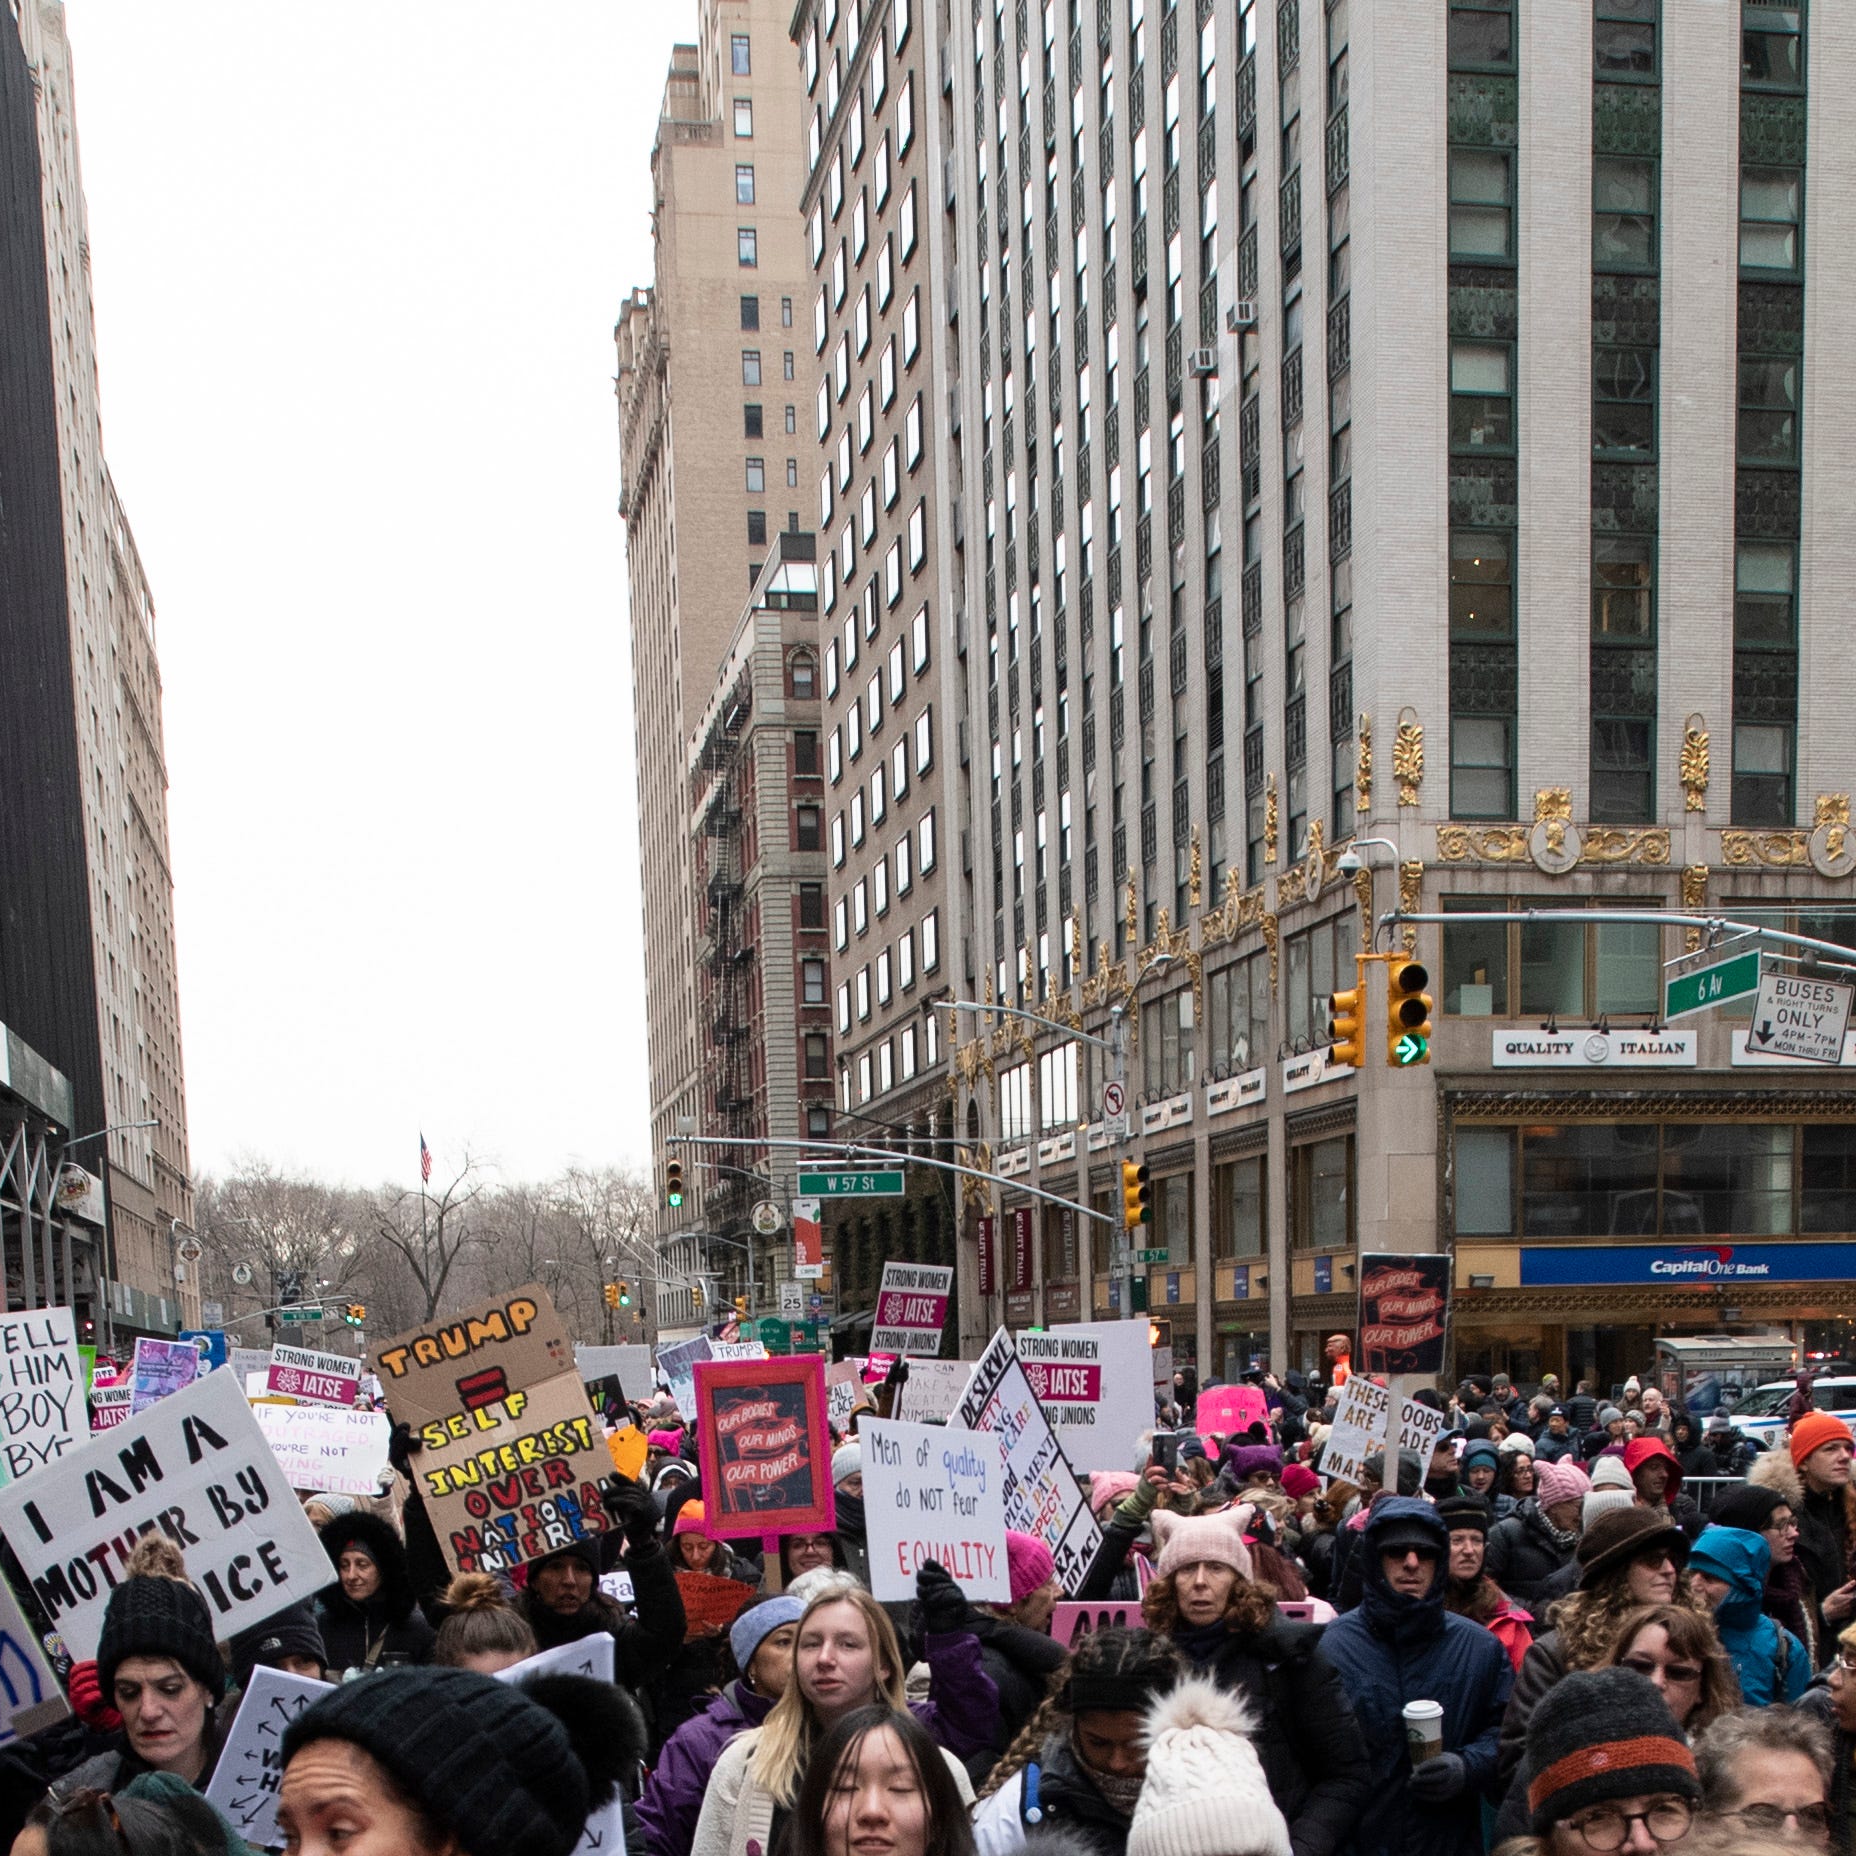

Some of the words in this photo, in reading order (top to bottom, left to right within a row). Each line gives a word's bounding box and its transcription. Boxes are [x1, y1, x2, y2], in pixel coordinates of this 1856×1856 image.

[1698, 978, 1706, 1001] 6
[1710, 975, 1723, 998] Av
[1776, 980, 1836, 1003] BUSES
[1777, 998, 1803, 1009] RIGHT
[1808, 1003, 1840, 1014] TURNS
[1776, 1009, 1824, 1029] ONLY
[1505, 1042, 1574, 1056] QUALITY
[1620, 1042, 1686, 1055] ITALIAN
[1774, 1041, 1795, 1053] MON
[826, 1178, 838, 1191] W
[842, 1177, 857, 1191] 57
[861, 1177, 875, 1191] St
[885, 1267, 917, 1287] STRONG
[919, 1271, 948, 1290] WOMEN
[1735, 1264, 1770, 1275] Bank
[1363, 1280, 1384, 1297] OUR
[783, 1298, 801, 1310] 25
[903, 1297, 937, 1324] IATSE
[1381, 1300, 1404, 1312] OUR
[378, 1298, 537, 1378] TRUMP
[874, 1330, 907, 1349] STRONG
[907, 1332, 937, 1351] UNIONS
[1364, 1327, 1394, 1344] OUR
[717, 1343, 763, 1360] TRUMPS
[1020, 1338, 1059, 1356] STRONG
[1061, 1341, 1098, 1359] WOMEN
[9, 1352, 74, 1387] HIM
[274, 1348, 317, 1369] STRONG
[317, 1353, 357, 1376] WOMEN
[301, 1374, 344, 1400] IATSE
[960, 1336, 1011, 1424] DESERVE
[1050, 1369, 1089, 1396] IATSE
[1347, 1379, 1390, 1414] THESE
[257, 1407, 269, 1419] IF
[346, 1414, 378, 1426] NOT
[420, 1390, 529, 1450] SELF
[717, 1412, 741, 1431] OUR
[742, 1402, 777, 1424] BODIES
[1059, 1406, 1096, 1425] UNIONS
[1343, 1405, 1376, 1432] ARE
[738, 1432, 764, 1448] OUR
[765, 1426, 798, 1447] MINDS
[320, 1445, 349, 1457] NOT
[423, 1416, 595, 1497] INTEREST
[871, 1431, 902, 1467] Men
[915, 1437, 930, 1468] of
[943, 1444, 986, 1495] quality
[84, 1435, 164, 1519] AM
[181, 1414, 229, 1465] A
[725, 1463, 756, 1483] OUR
[759, 1453, 799, 1480] POWER
[206, 1464, 270, 1530] BY
[464, 1458, 576, 1519] OVER
[895, 1481, 911, 1510] do
[919, 1488, 944, 1512] NOT
[952, 1491, 978, 1518] fear
